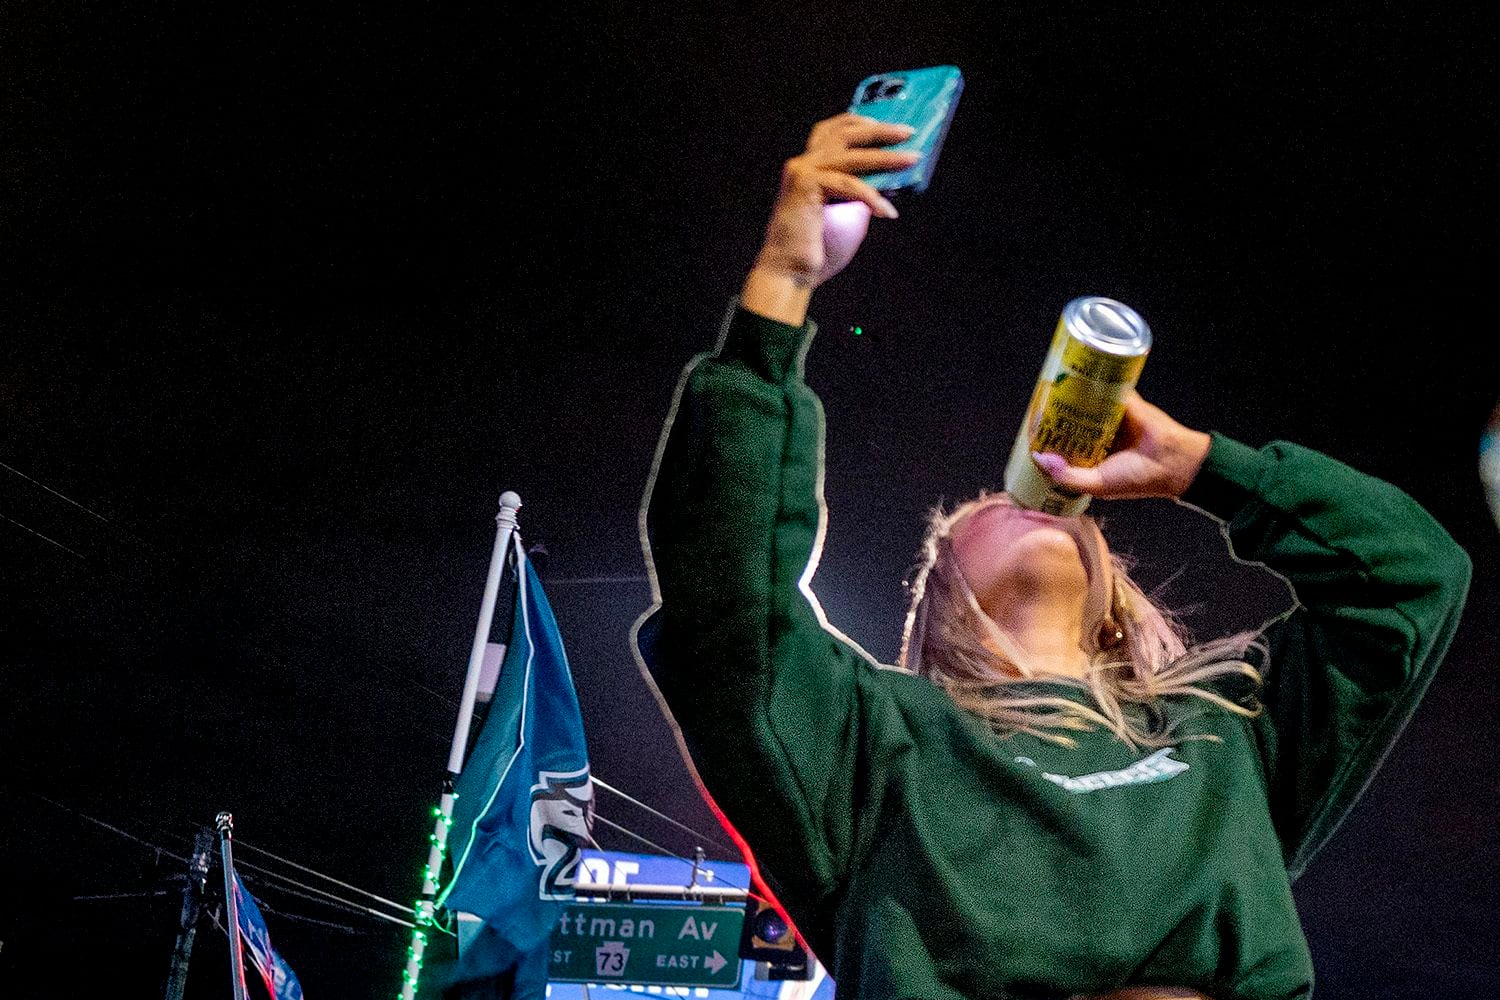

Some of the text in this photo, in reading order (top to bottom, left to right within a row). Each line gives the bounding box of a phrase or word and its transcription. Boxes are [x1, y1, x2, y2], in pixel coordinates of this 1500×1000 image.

[560, 912, 718, 941] ttman Av
[553, 951, 700, 972] ST 73 EAST
